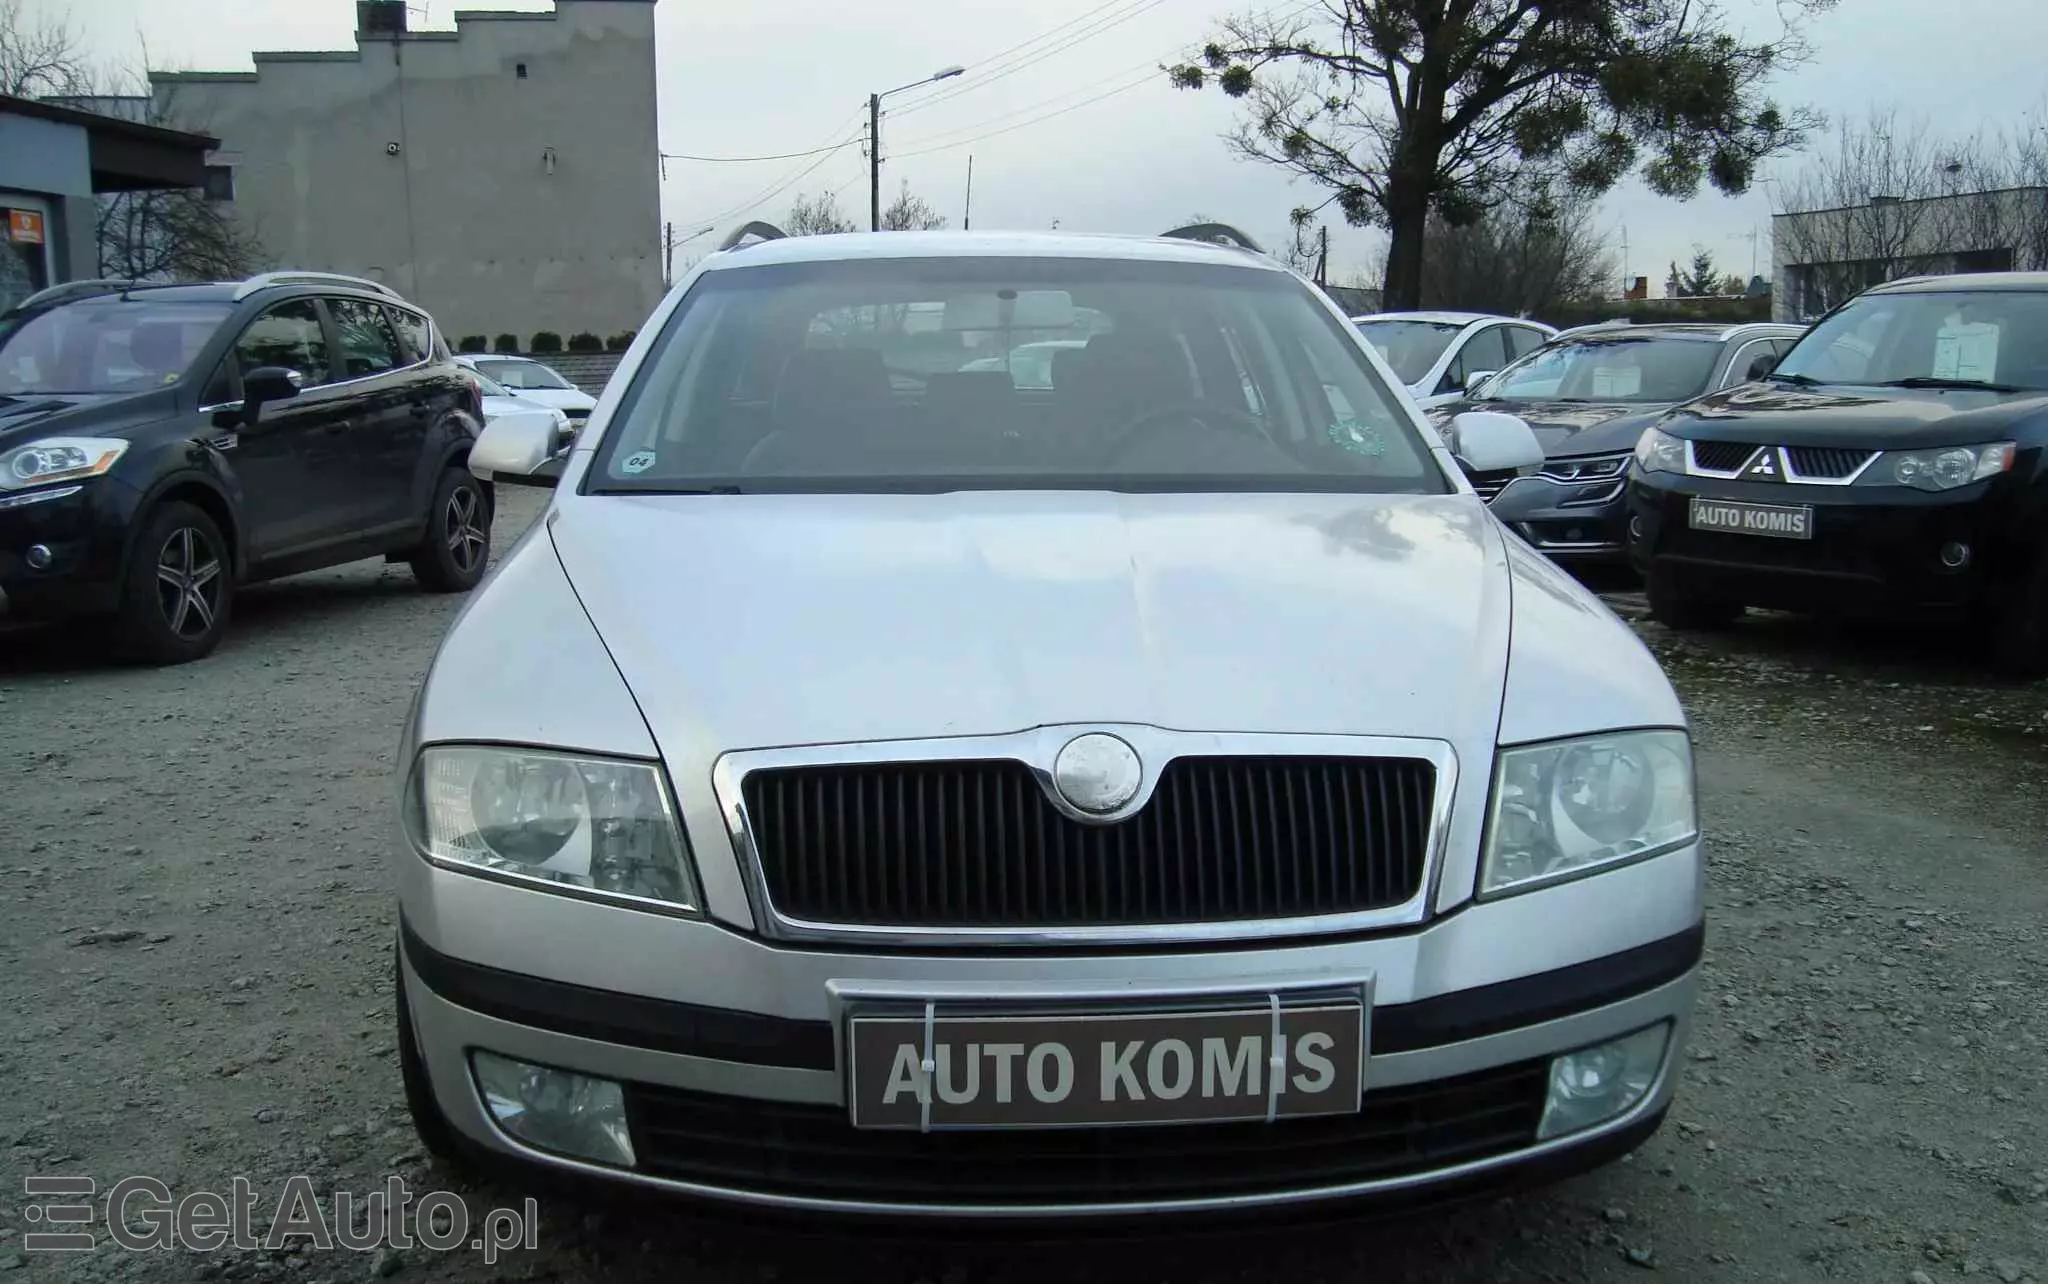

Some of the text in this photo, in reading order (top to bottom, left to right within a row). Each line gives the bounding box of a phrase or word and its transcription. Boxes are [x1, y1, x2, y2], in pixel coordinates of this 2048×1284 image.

[1696, 506, 1805, 533] AUTO KOMIS
[882, 1031, 1336, 1104] AUTO KOMIS
